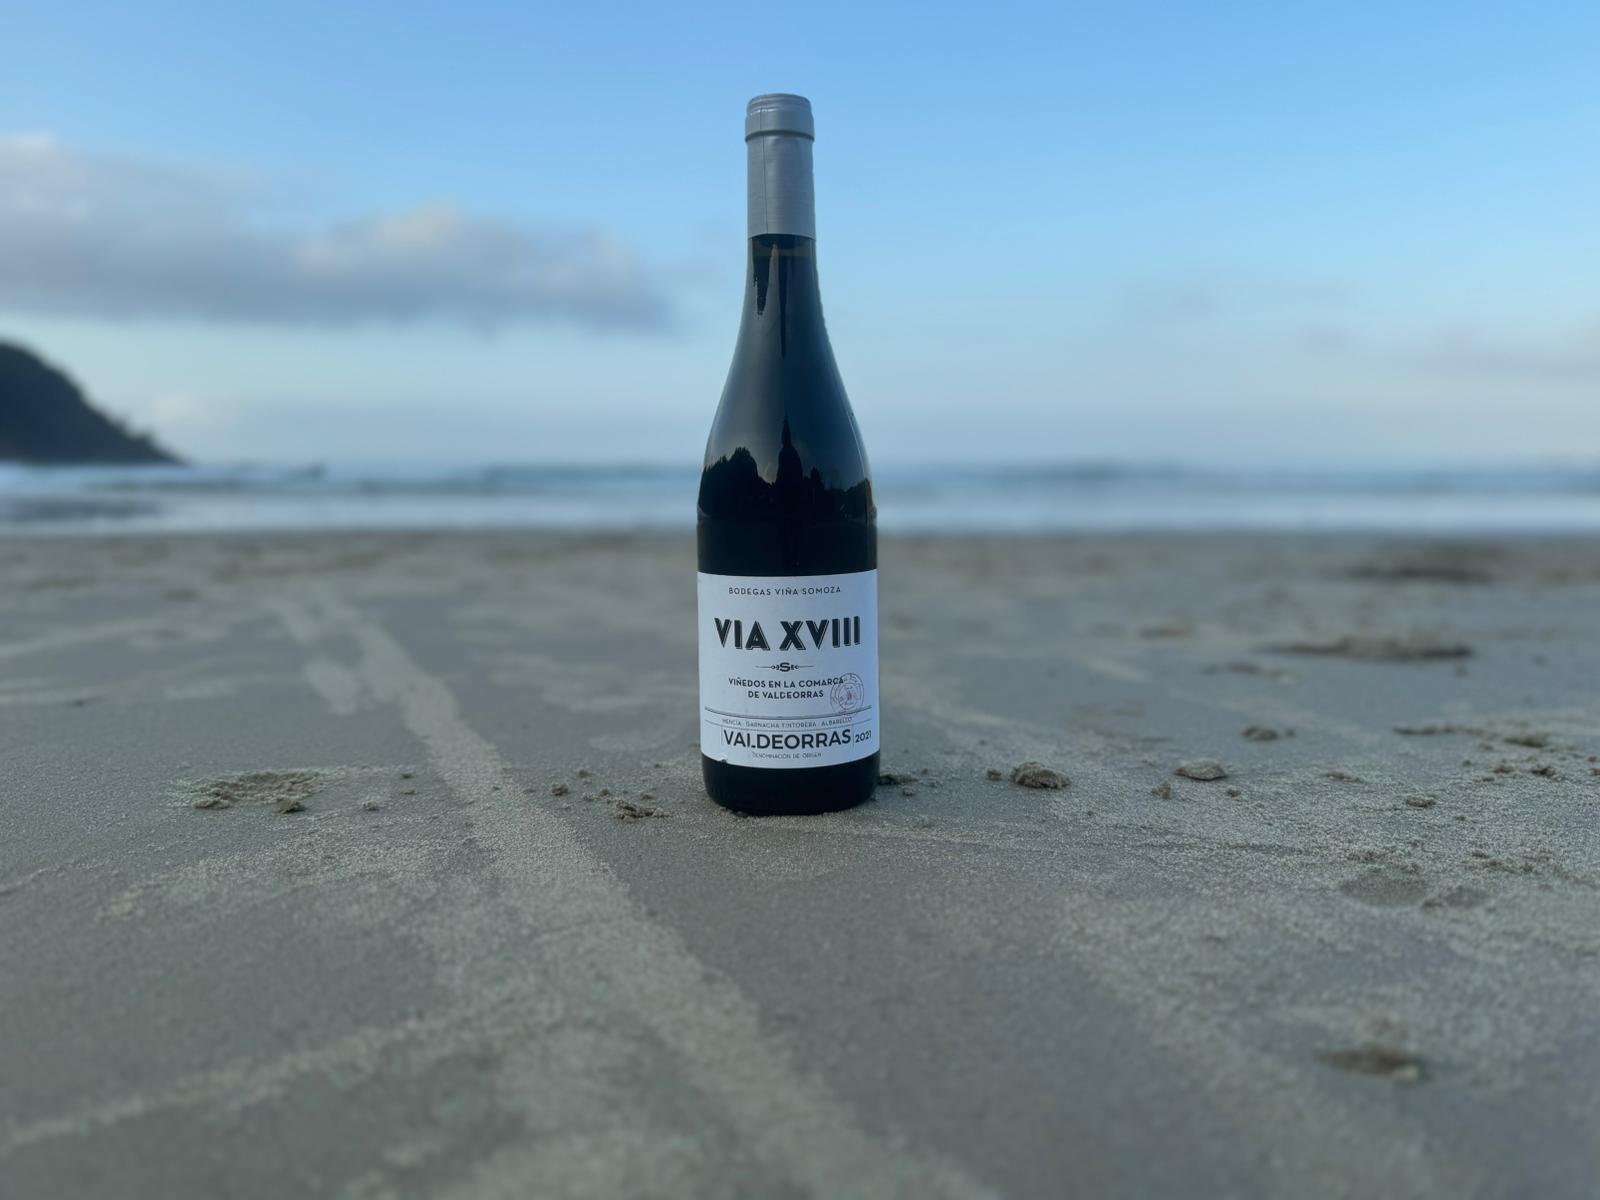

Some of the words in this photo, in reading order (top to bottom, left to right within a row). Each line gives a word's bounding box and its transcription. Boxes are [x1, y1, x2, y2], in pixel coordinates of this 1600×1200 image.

[728, 587, 771, 596] BODEGAS
[774, 586, 799, 596] VIÑA
[802, 586, 841, 595] SOMOZA
[714, 617, 771, 651] VIA
[779, 615, 861, 651] XVIII
[728, 676, 766, 688] VIÑEDOS
[768, 680, 781, 688] EN
[783, 680, 796, 688] LA
[799, 677, 844, 688] COMARCA
[748, 691, 759, 699] DE
[763, 690, 824, 699] VALDEORRAS
[723, 729, 851, 750] VALDEORRAS
[855, 730, 872, 743] 2021
